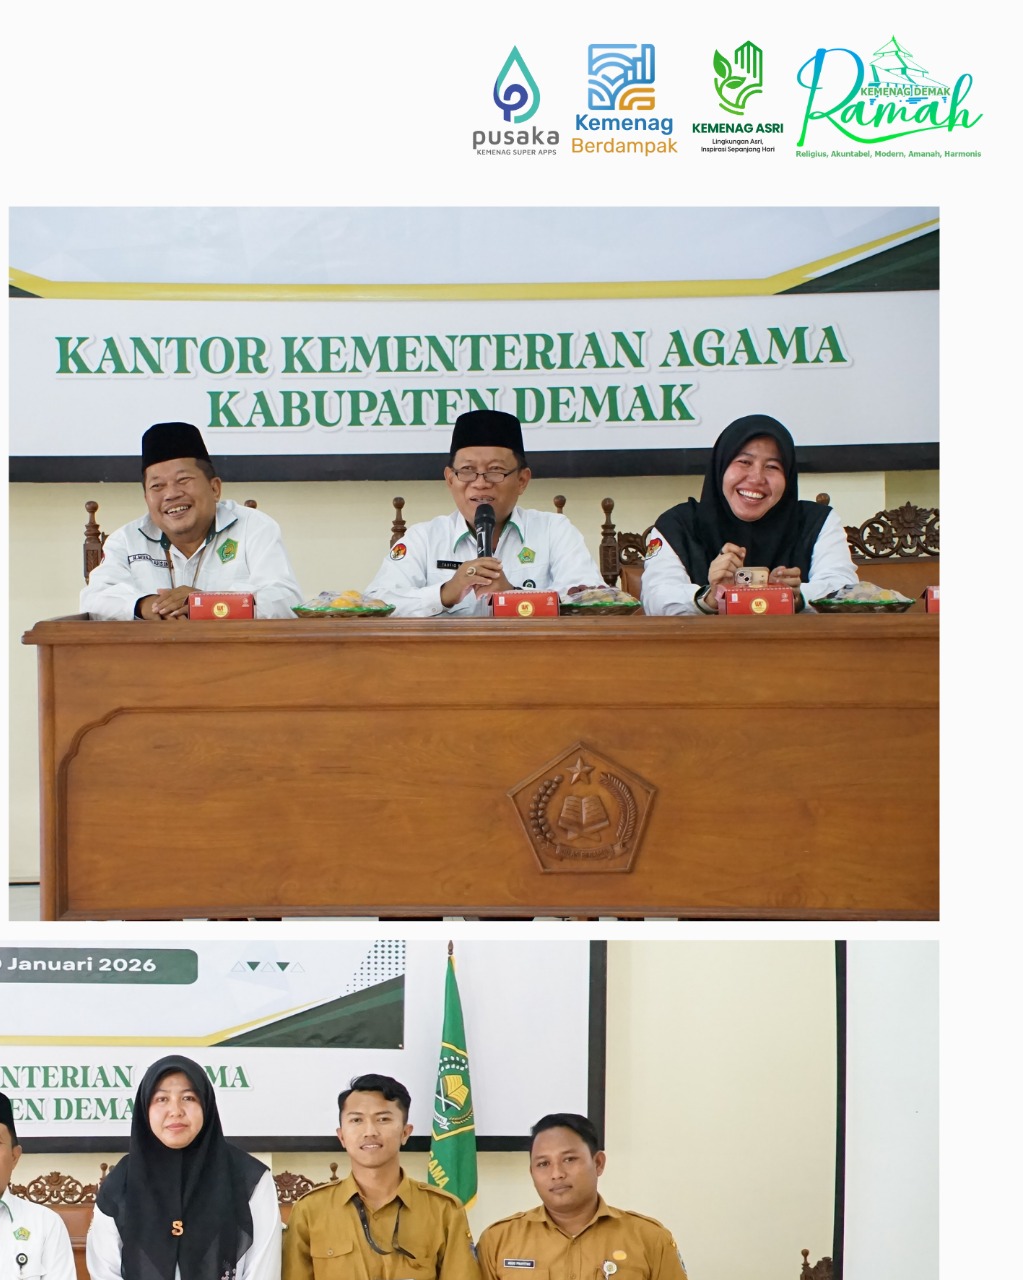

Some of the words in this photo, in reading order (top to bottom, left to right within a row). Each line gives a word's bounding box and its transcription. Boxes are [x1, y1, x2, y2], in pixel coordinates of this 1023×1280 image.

[54, 336, 269, 375] KANTOR
[280, 330, 647, 376] KEMENTERIAN
[658, 324, 848, 369] AGAMA
[206, 387, 499, 428] KABUPATEN
[511, 382, 696, 425] DEMAK
[6, 956, 93, 971] Januari
[98, 957, 157, 973] 2026
[54, 1097, 136, 1121] DEMA
[171, 1219, 184, 1236] S
